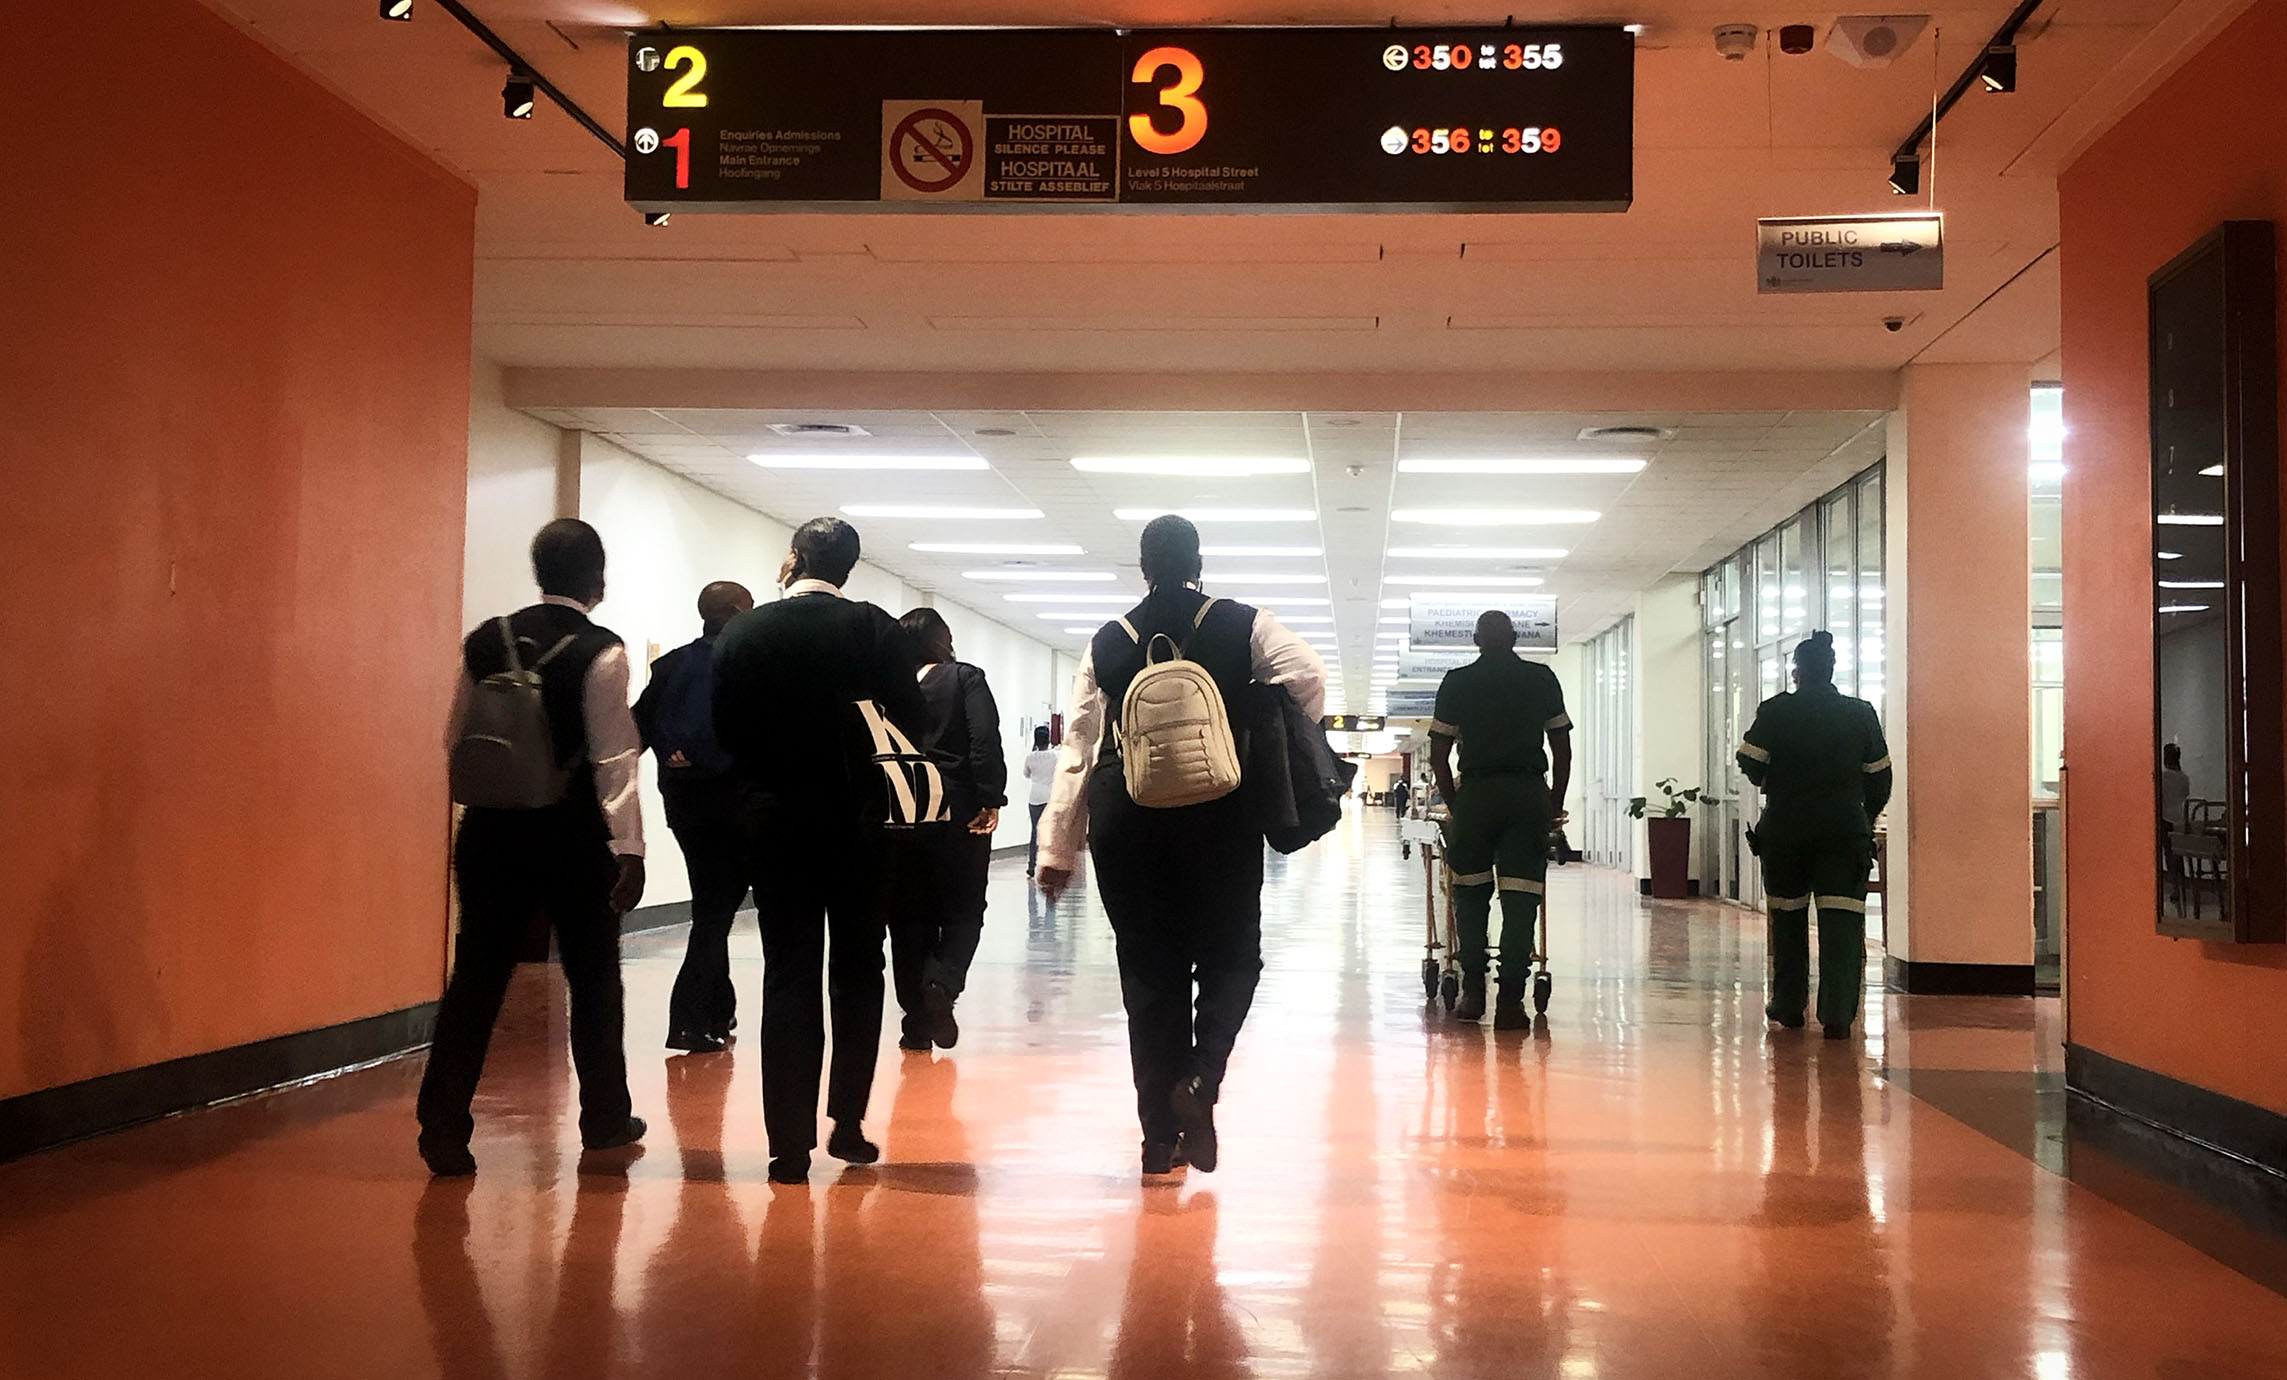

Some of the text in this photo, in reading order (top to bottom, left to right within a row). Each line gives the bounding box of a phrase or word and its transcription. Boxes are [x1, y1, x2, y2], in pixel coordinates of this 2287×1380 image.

[1413, 44, 1472, 70] 350
[1503, 44, 1563, 70] 355
[663, 45, 708, 107] 2
[1129, 47, 1208, 154] 3
[719, 130, 841, 141] Enquiries Admissions
[1008, 125, 1094, 140] HOSPITAL
[1412, 128, 1470, 154] 356
[1502, 128, 1561, 154] 359
[995, 144, 1106, 155] SILENCE PLEASE
[662, 127, 691, 189] 1
[719, 155, 800, 165] Main Entrance
[1001, 161, 1100, 177] HOSPITAAL
[1128, 167, 1259, 179] Level 5 Hospital Street
[990, 181, 1110, 192] STILTE ASSEBLIEF
[1128, 180, 1152, 191] Vlak
[1154, 180, 1162, 191] 5
[1782, 230, 1858, 246] PUBLIC
[1776, 252, 1864, 269] TOILETS
[1333, 715, 1345, 729] 2
